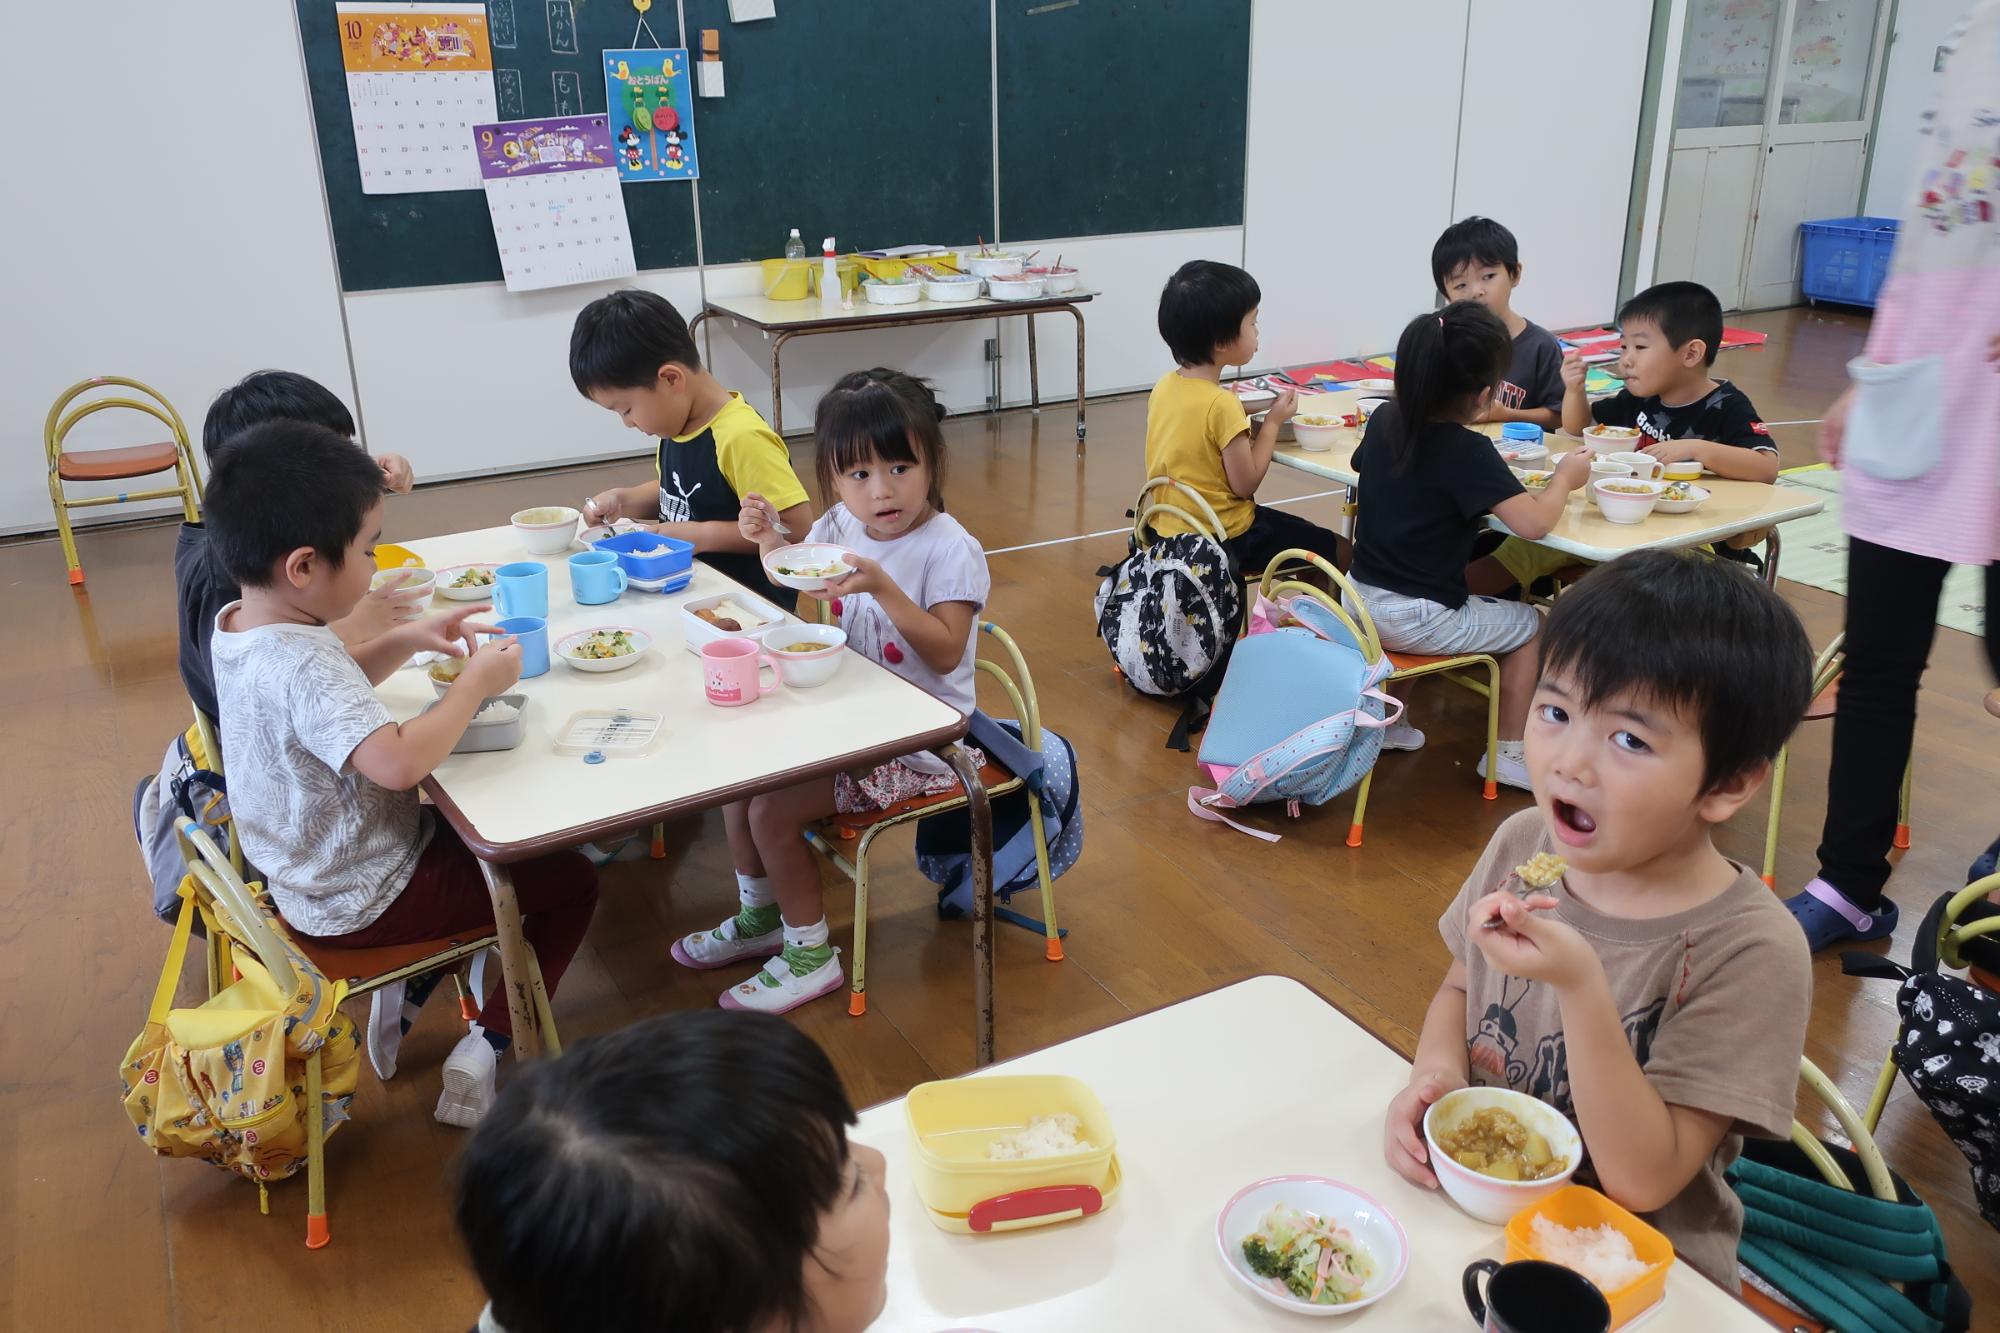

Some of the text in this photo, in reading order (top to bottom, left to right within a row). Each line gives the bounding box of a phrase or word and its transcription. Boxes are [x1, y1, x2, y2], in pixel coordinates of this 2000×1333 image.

[345, 20, 362, 40] 10
[627, 75, 669, 86] おとうばん
[481, 131, 494, 150] 9
